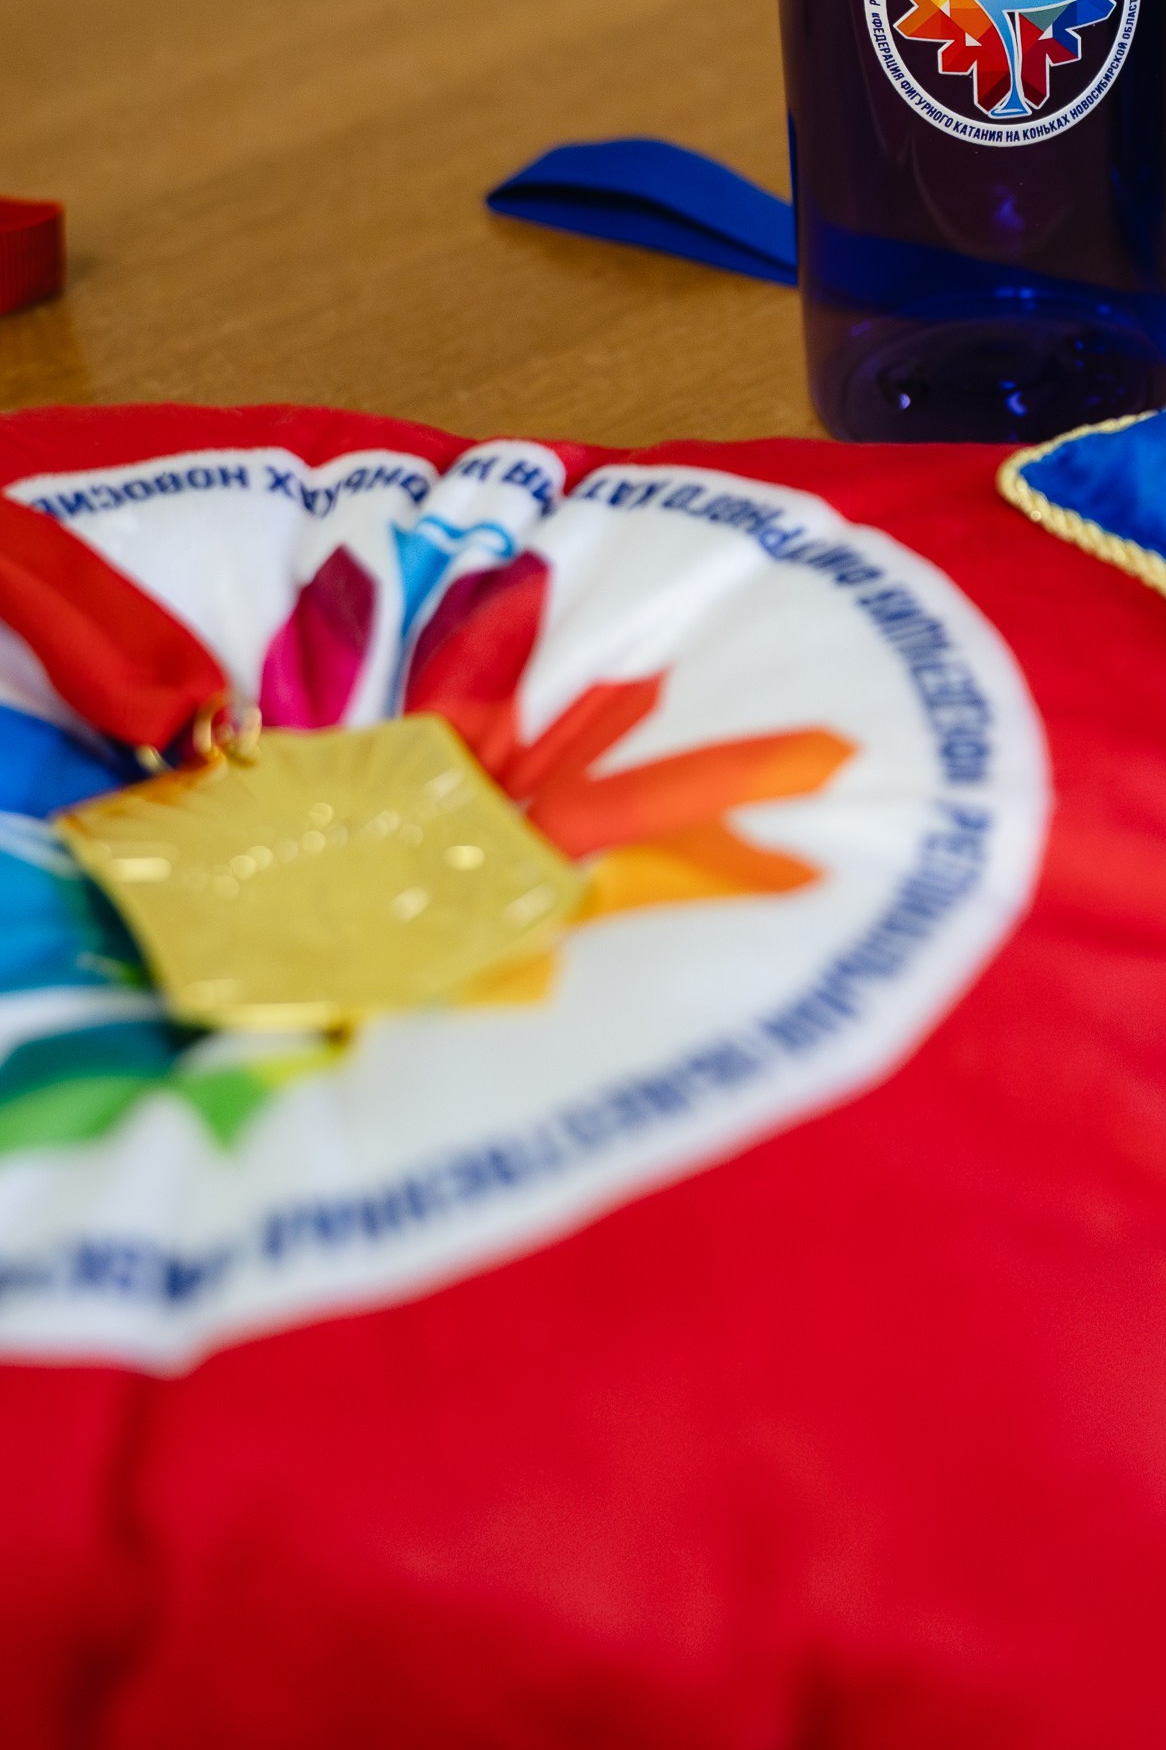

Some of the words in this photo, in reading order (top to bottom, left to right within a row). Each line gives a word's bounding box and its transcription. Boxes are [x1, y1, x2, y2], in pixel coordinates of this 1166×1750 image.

[900, 79, 954, 129] ФИГУРНОГО
[953, 121, 1004, 143] КАТАНИЯ
[1005, 130, 1021, 143] НА
[1022, 113, 1071, 142] КОНЬКАХ
[1070, 41, 1128, 121] НОВОСИБИРСКОЙ
